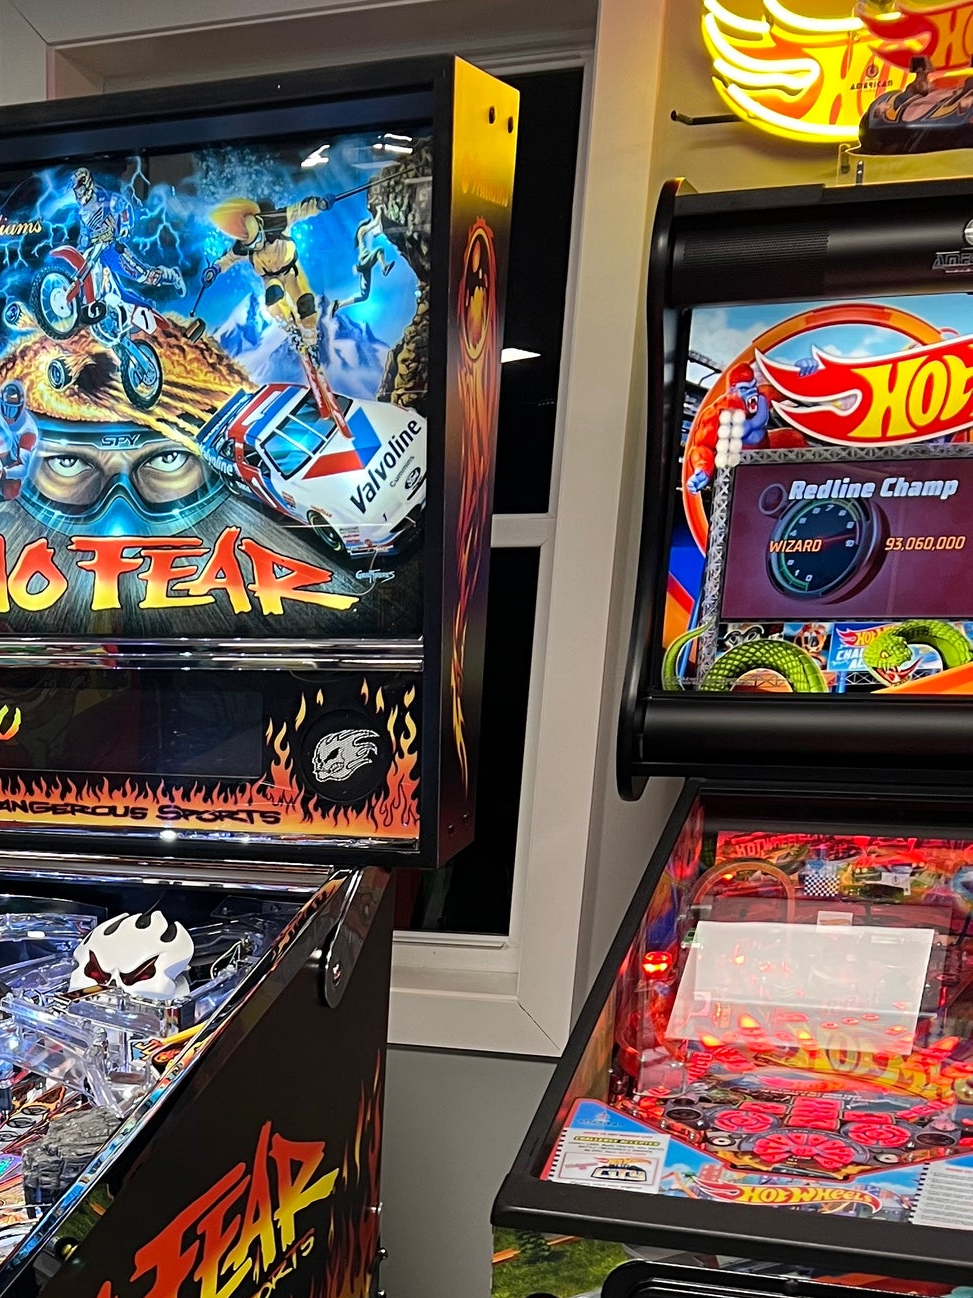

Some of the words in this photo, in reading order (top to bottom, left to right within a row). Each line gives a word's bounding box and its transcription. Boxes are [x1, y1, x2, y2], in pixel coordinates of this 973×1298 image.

[101, 433, 141, 446] SPY
[350, 419, 422, 514] Valvoline
[788, 477, 876, 500] Redline
[880, 477, 959, 500] Champ
[769, 539, 822, 552] WIZARD
[884, 536, 966, 552] 93,060,000
[68, 525, 360, 615] FEAR
[156, 803, 282, 825] SPORTS
[738, 1186, 791, 1203] HOT
[785, 1187, 873, 1204] WHEELS
